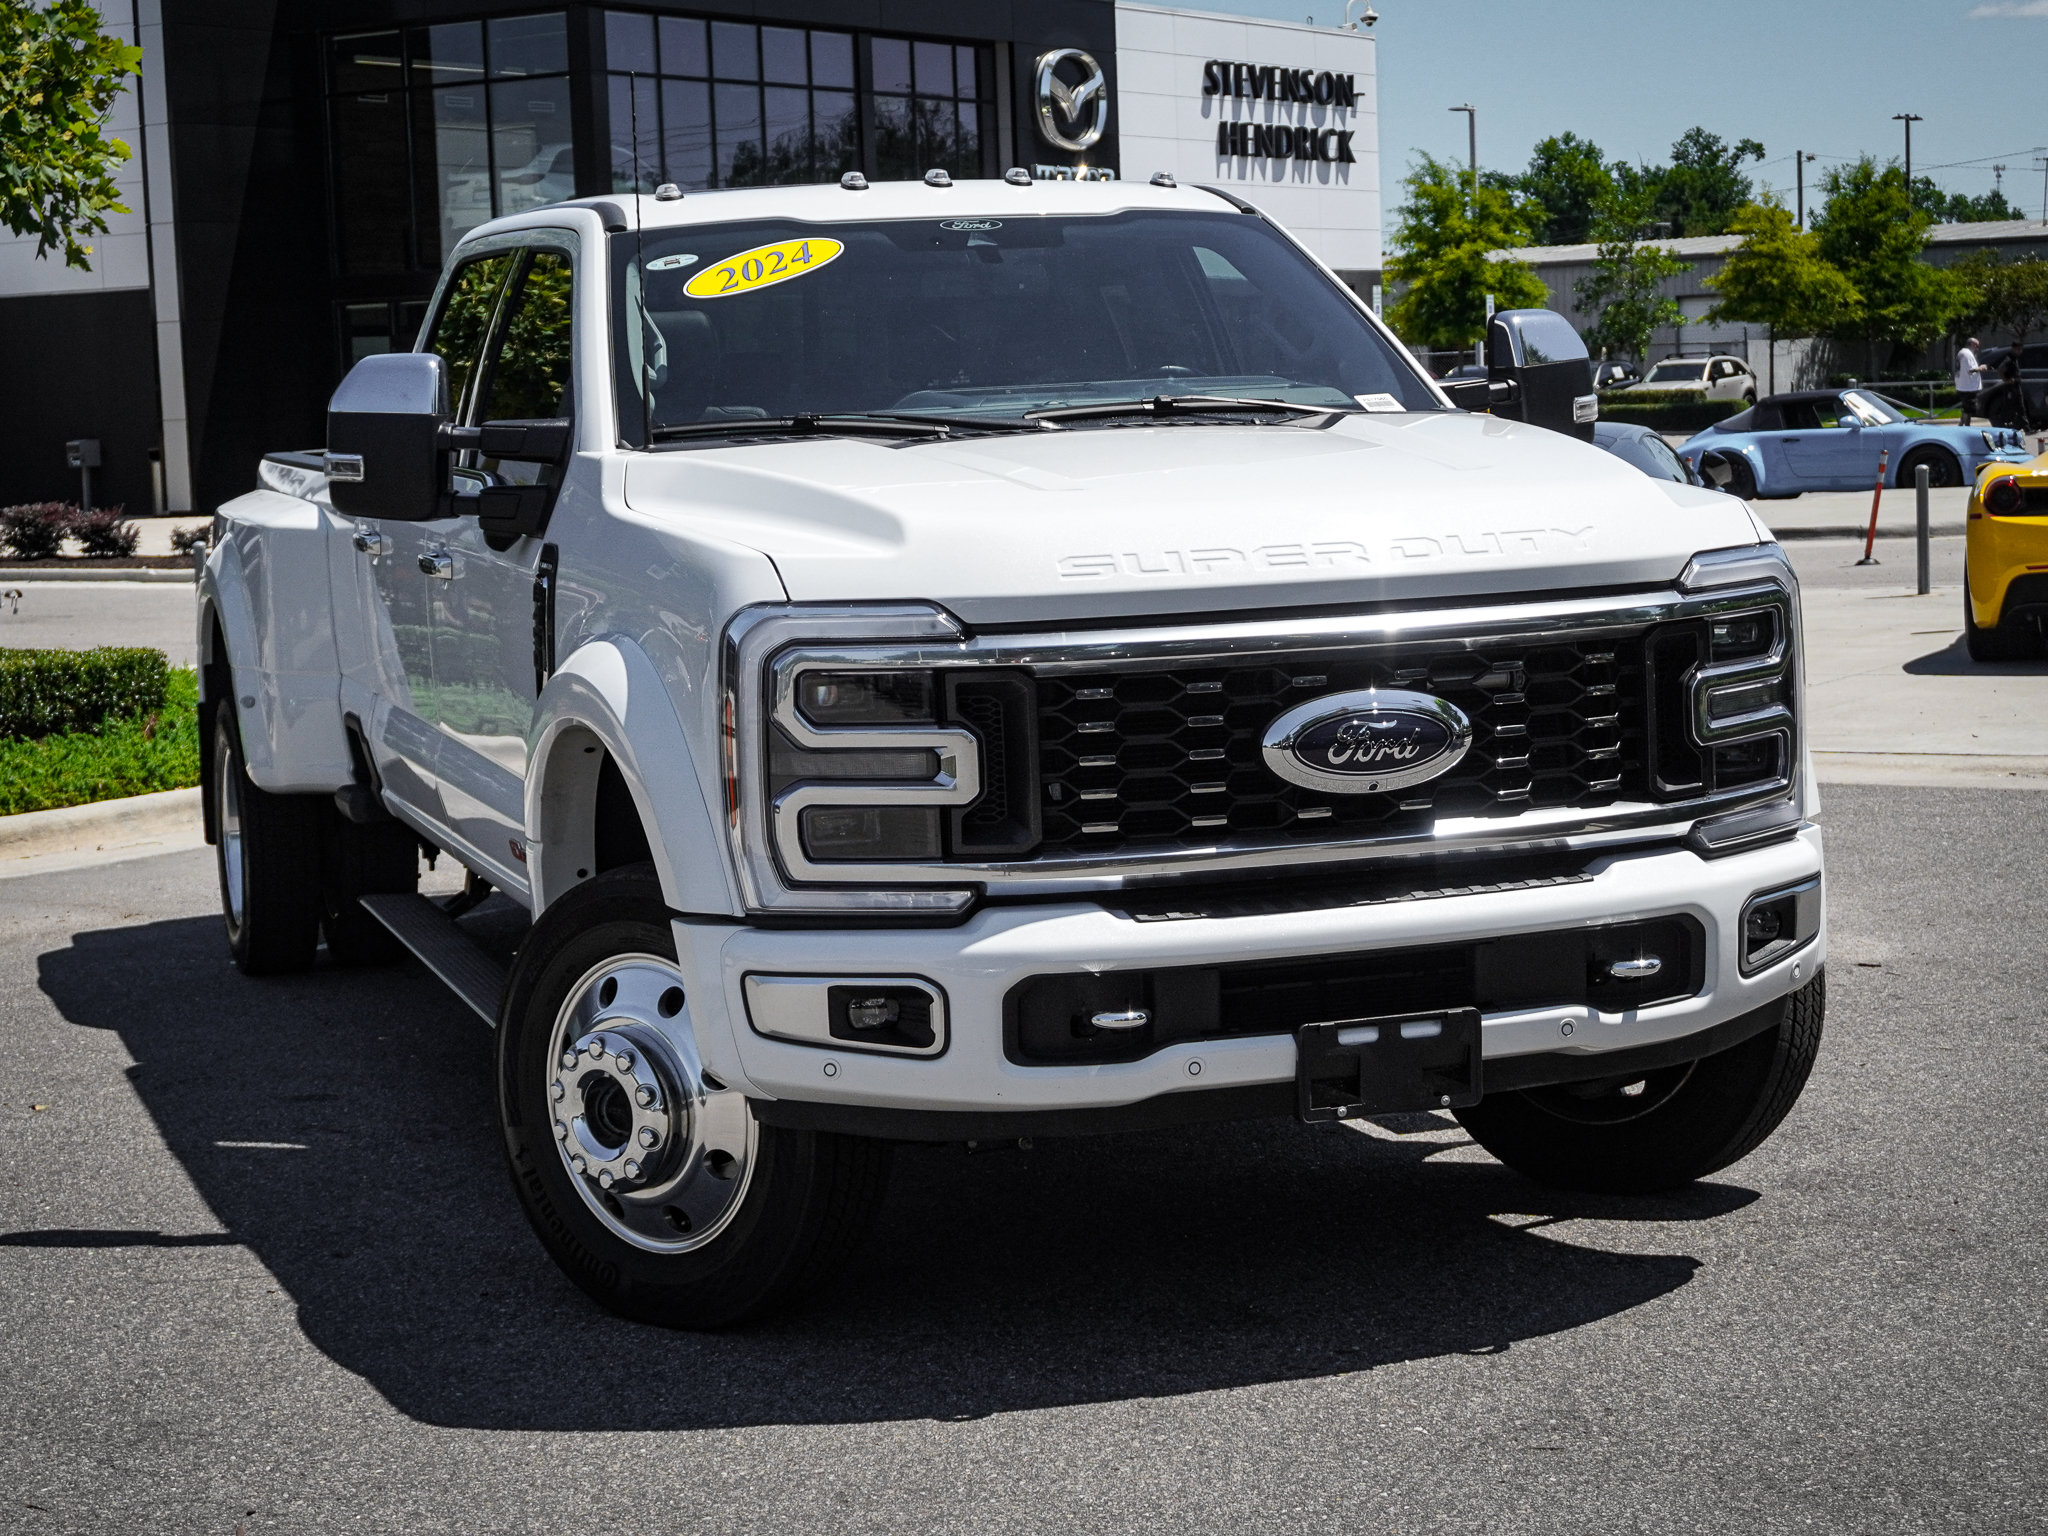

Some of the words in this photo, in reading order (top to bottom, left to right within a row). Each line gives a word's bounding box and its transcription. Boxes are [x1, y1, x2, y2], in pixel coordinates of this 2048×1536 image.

[1218, 121, 1357, 164] HENDRICK
[951, 220, 992, 230] Ford
[716, 241, 813, 293] 2024
[1056, 541, 1371, 581] SUPER
[1390, 525, 1595, 561] DUTY
[1327, 720, 1421, 765] Ford
